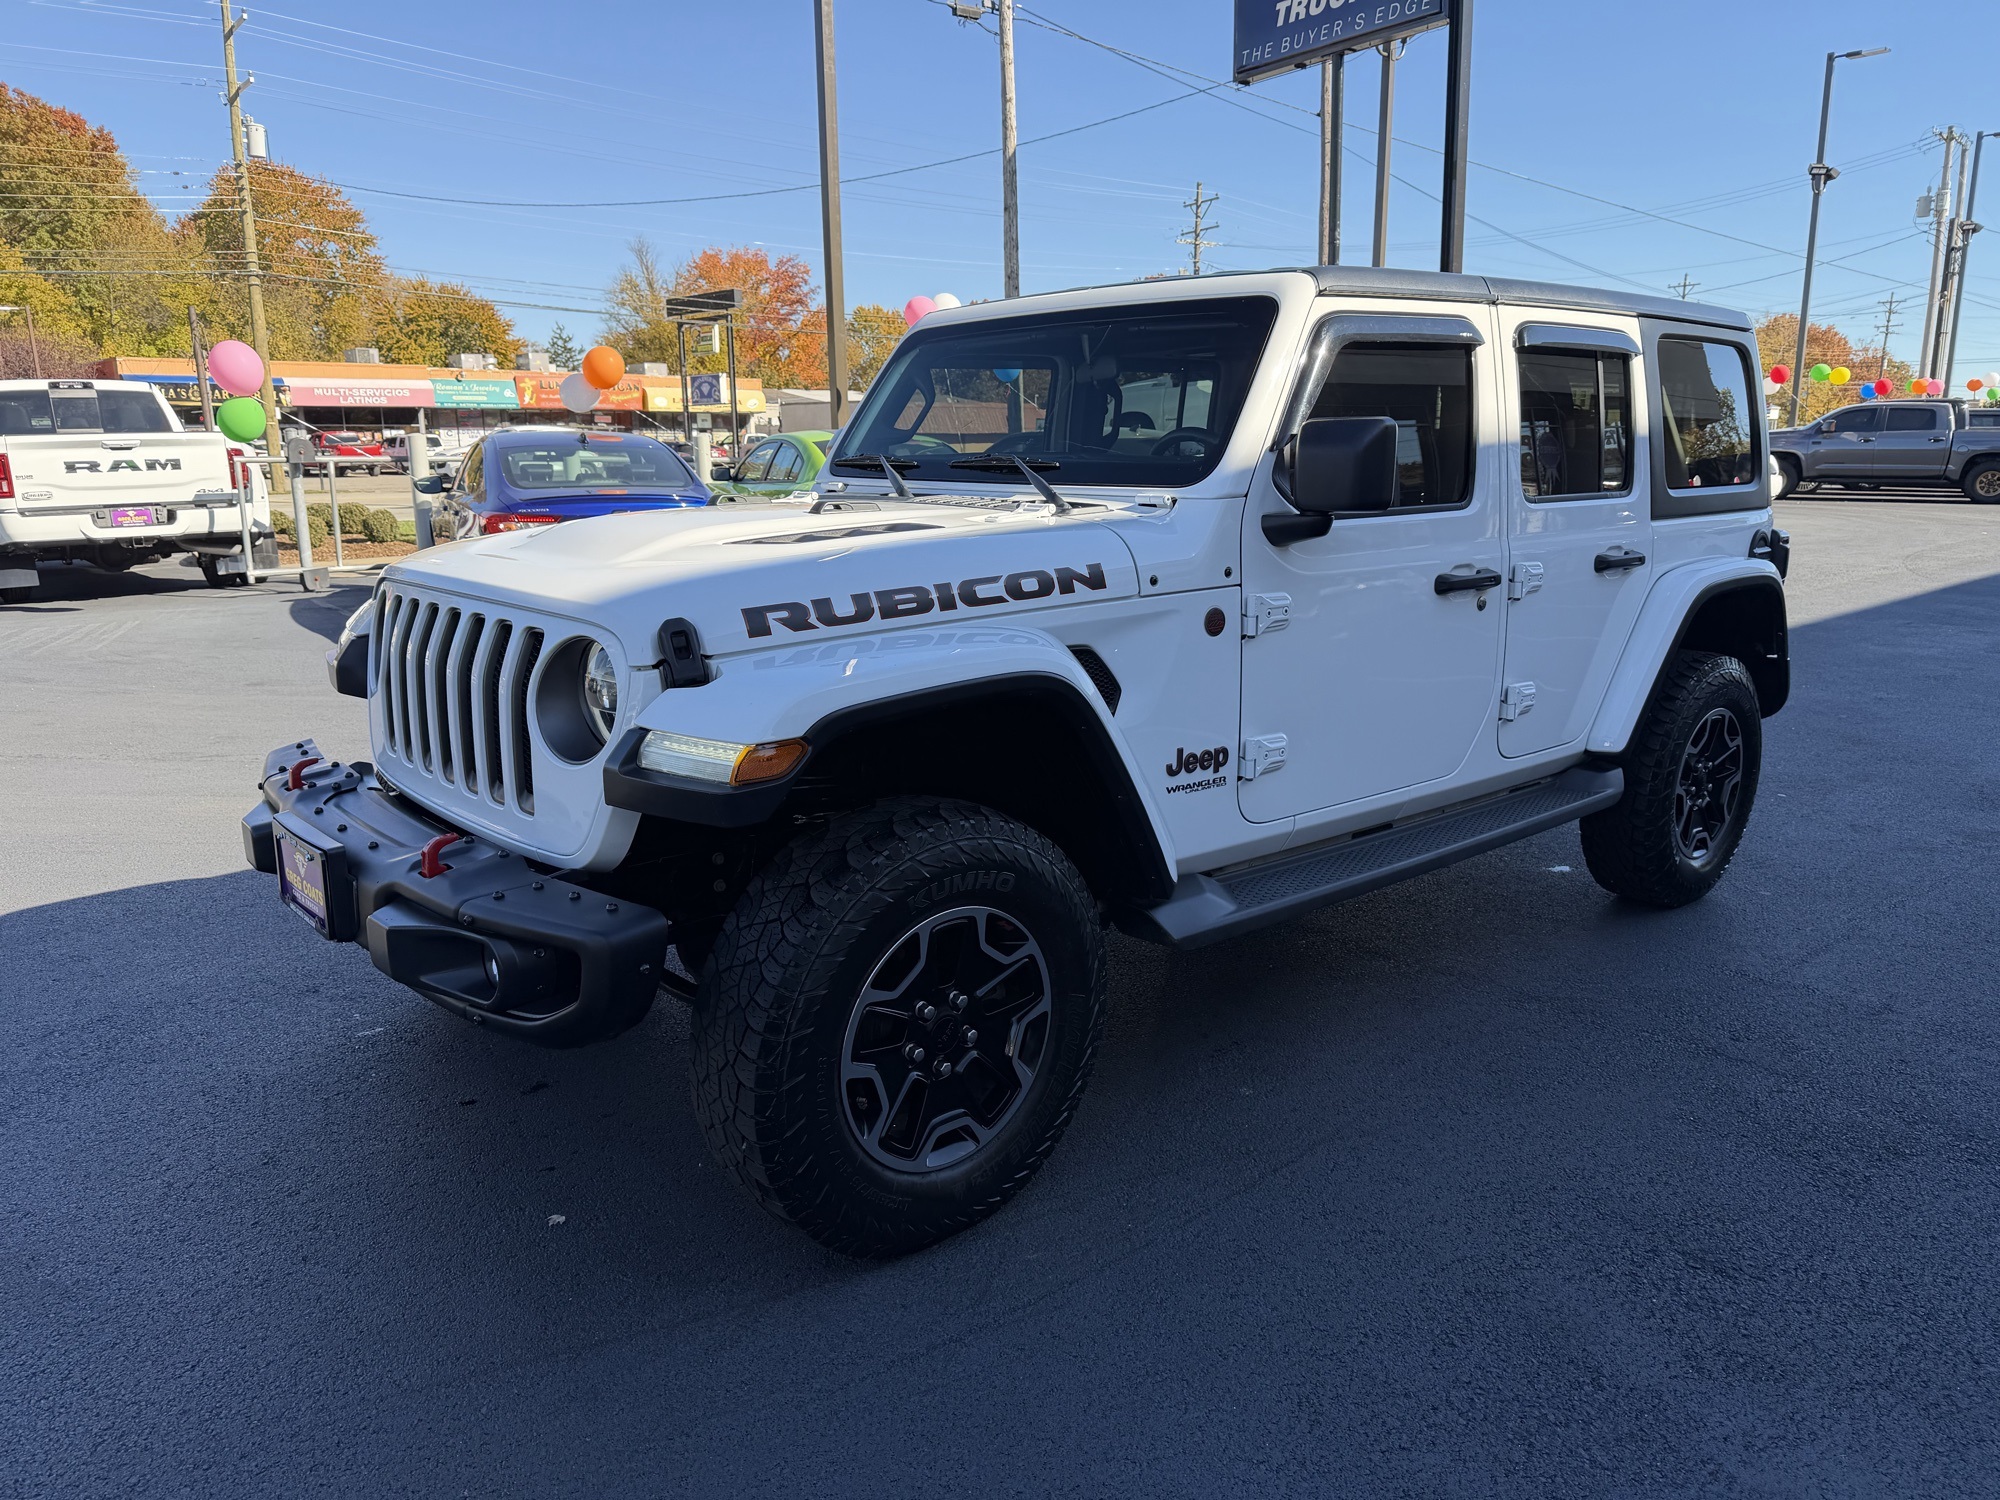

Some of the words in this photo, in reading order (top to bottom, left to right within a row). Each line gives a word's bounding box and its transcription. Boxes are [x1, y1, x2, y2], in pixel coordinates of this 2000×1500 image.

[1276, 0, 1356, 27] TRU
[1242, 42, 1274, 65] THE
[1280, 13, 1365, 53] BUYER'S
[1374, 0, 1430, 24] EDGE
[314, 387, 410, 397] MULTI-SERVICIOS
[339, 396, 388, 405] LATINOS
[63, 458, 182, 474] RAM
[741, 563, 1107, 638] RUBICON
[1166, 746, 1229, 777] Jeep
[1166, 776, 1227, 794] WRANGLER
[1185, 783, 1227, 794] UNLIMITED
[286, 867, 301, 891] GREG
[303, 880, 323, 906] COATS
[907, 870, 1017, 915] KUMHO
